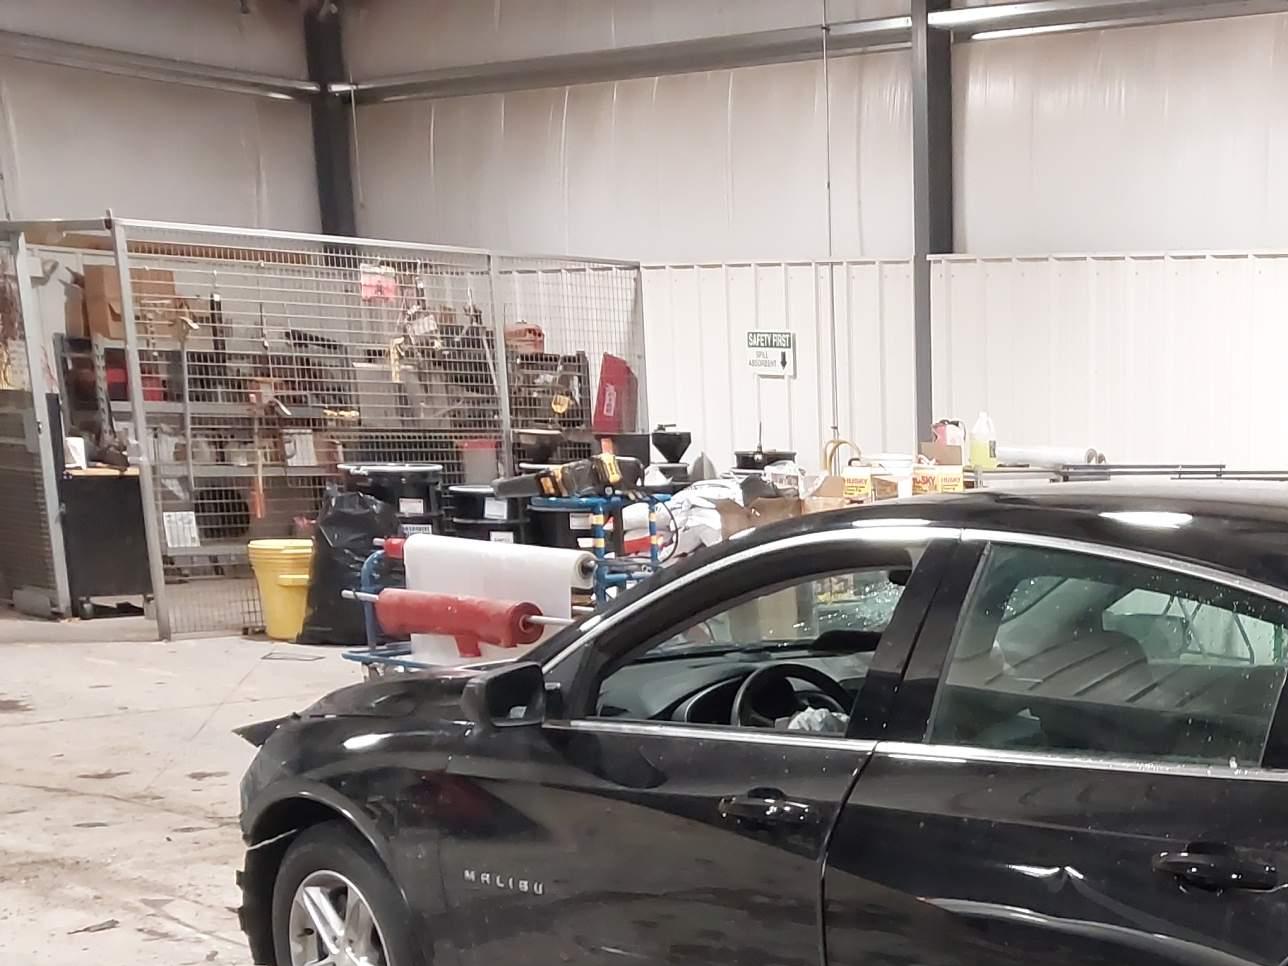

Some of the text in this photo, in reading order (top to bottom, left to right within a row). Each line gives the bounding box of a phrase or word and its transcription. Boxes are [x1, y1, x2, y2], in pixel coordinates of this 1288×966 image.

[748, 333, 790, 347] SAFETY FIRST
[463, 869, 544, 895] MALIBU
